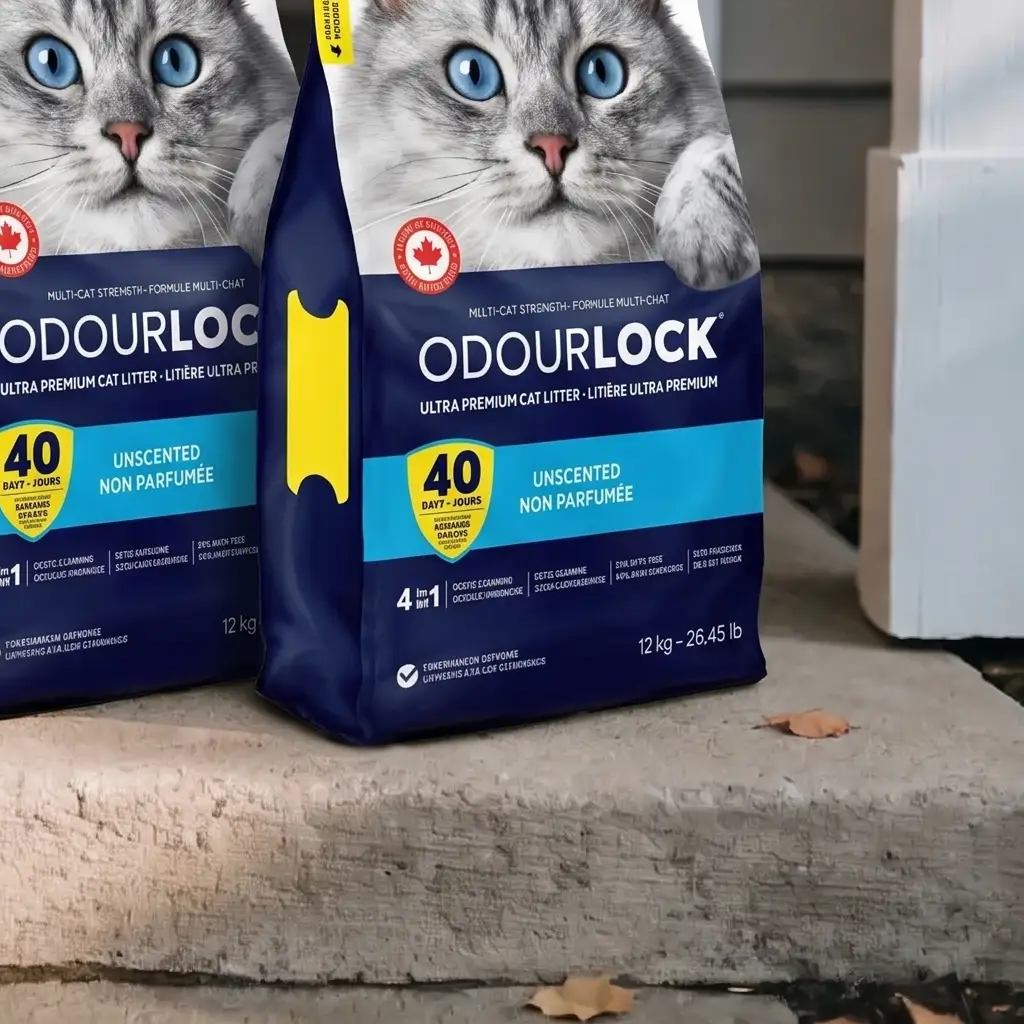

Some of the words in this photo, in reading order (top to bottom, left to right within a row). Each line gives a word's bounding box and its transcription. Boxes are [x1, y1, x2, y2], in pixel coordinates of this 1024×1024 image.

[47, 288, 95, 301] MULTI-CAT
[193, 278, 246, 292] MULTI-CHAT
[418, 315, 718, 382] ODOURLOCK
[0, 381, 38, 396] ULTRA
[40, 376, 96, 393] PREMIUM
[98, 374, 119, 388] CAT
[121, 370, 157, 386] LITTER
[207, 363, 242, 377] ULTRA
[420, 399, 459, 415] ULTRA
[462, 393, 517, 412] PREMIUM
[519, 391, 542, 406] CAT
[543, 388, 580, 404] LITTER
[629, 380, 664, 396] ULTRA
[666, 375, 718, 392] PREMIUM
[4, 430, 61, 477] 40
[113, 444, 200, 469] UNSCENTED
[32, 476, 61, 487] JOURS
[99, 477, 132, 495] NON
[136, 463, 214, 491] PARFUMÉE
[423, 449, 481, 496] 40
[533, 463, 621, 488] UNSCENTED
[452, 496, 482, 507] JOURS
[519, 496, 553, 514] NON
[556, 483, 634, 510] PARFUMÉE
[10, 563, 21, 586] 1
[396, 587, 412, 611] 4
[429, 584, 440, 607] 1
[221, 617, 237, 635] 12
[239, 614, 257, 636] kg
[638, 638, 653, 656] 12
[656, 634, 673, 656] kg
[729, 622, 743, 640] lb
